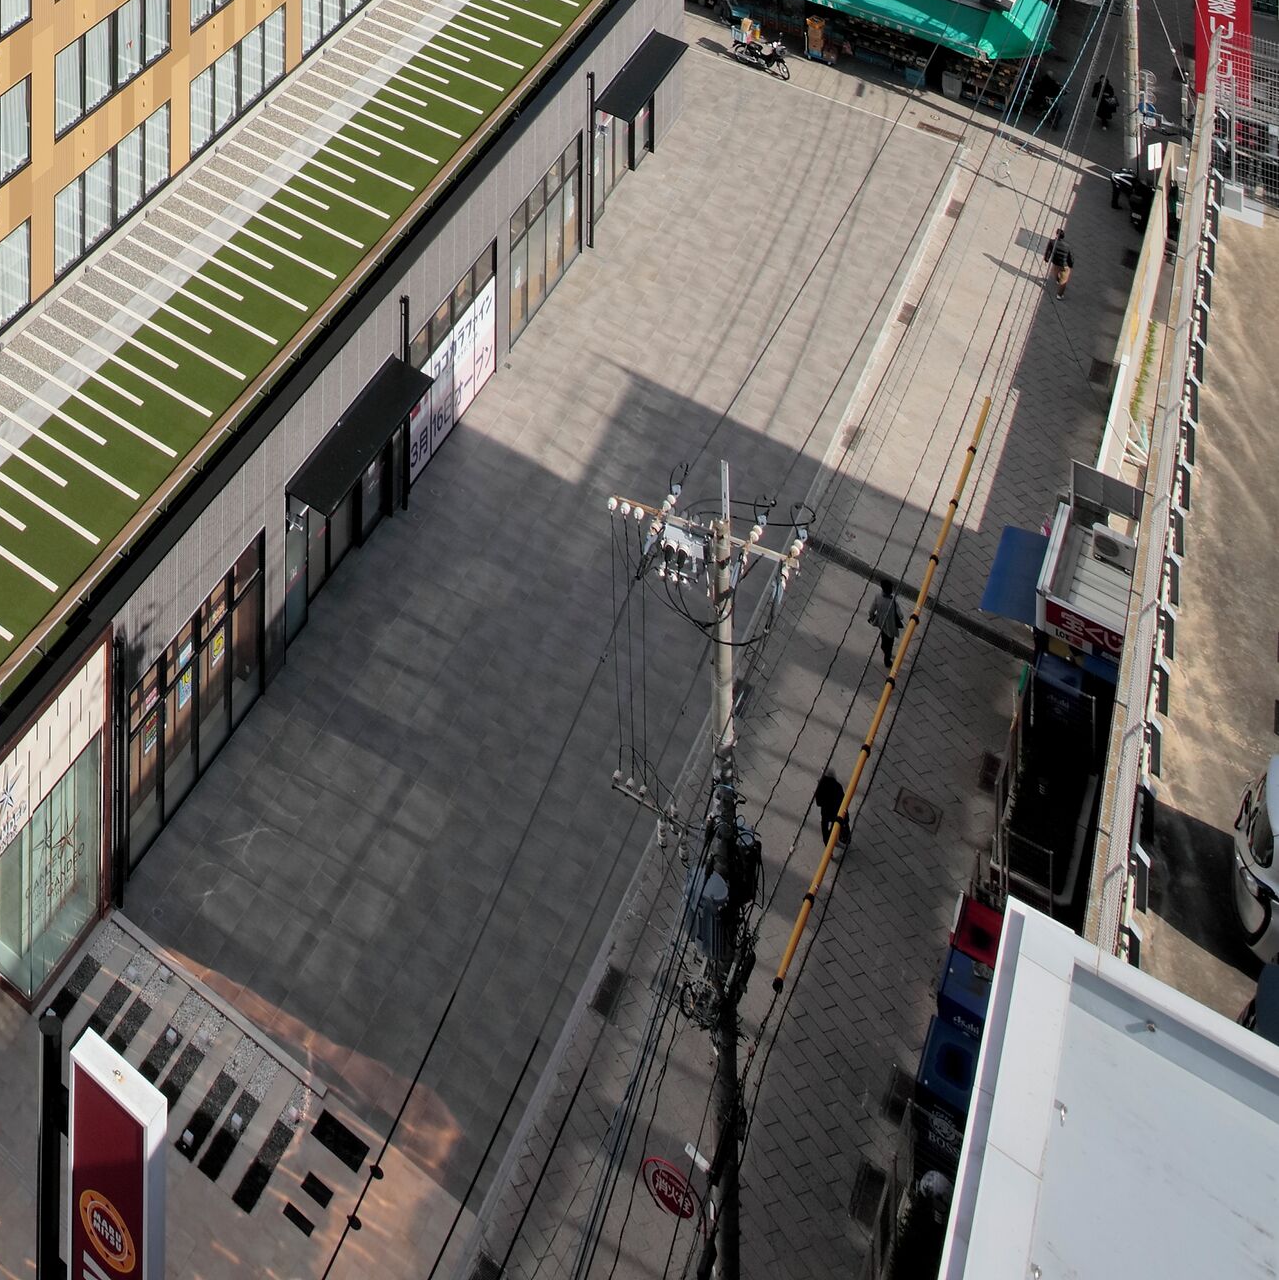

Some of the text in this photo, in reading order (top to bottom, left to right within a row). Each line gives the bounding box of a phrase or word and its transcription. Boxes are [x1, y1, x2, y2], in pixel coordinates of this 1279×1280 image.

[1060, 611, 1124, 653] 宝くじ
[952, 1015, 980, 1037] Asahi
[928, 1130, 961, 1158] BOSS
[93, 1209, 122, 1243] MARU
[93, 1219, 122, 1252] MITSU
